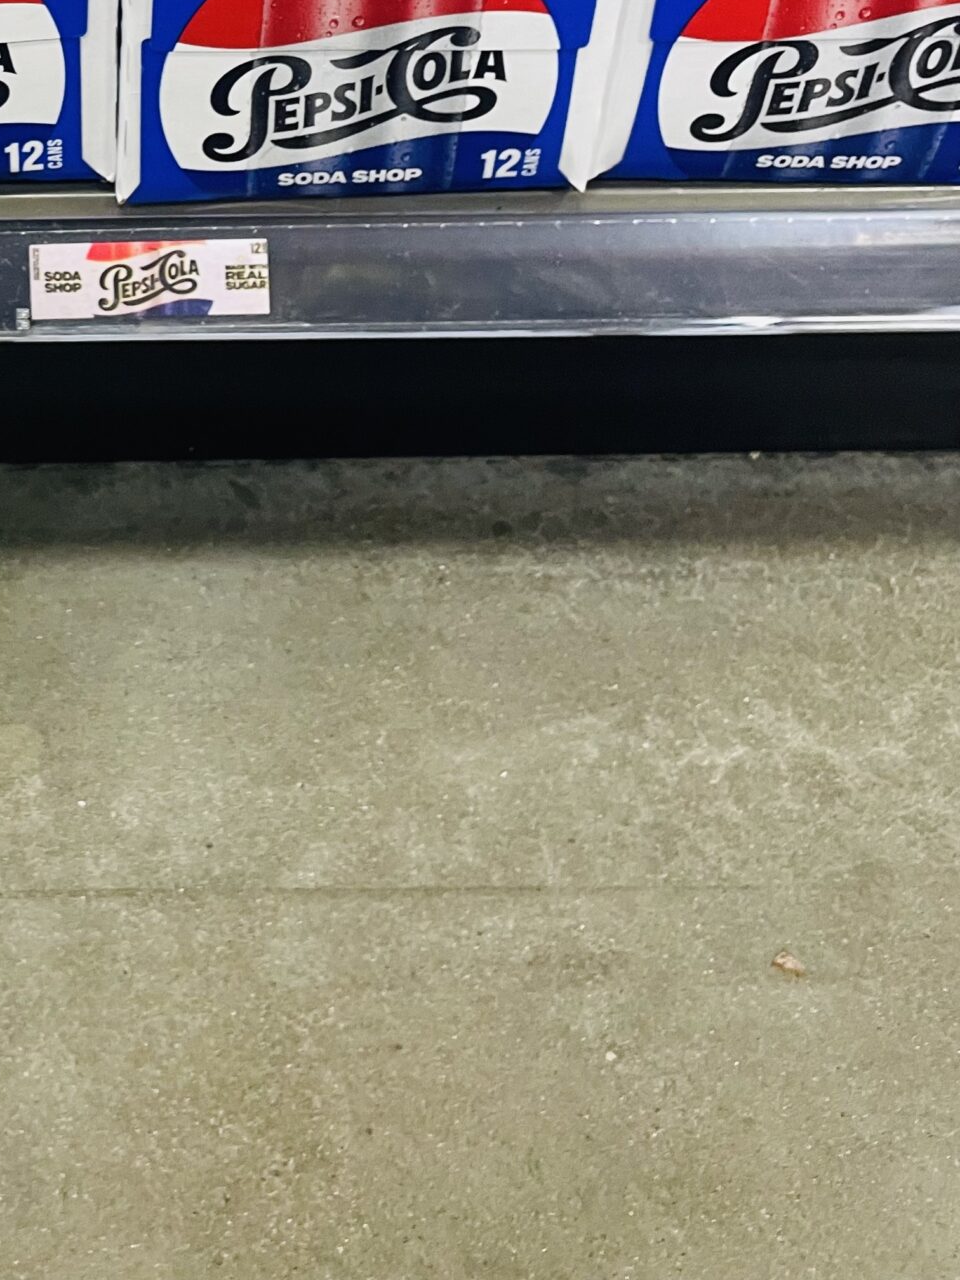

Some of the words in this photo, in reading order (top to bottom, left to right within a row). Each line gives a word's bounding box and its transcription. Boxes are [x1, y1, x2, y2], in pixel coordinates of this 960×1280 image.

[4, 140, 45, 172] 12
[47, 138, 63, 169] CANS
[481, 149, 521, 178] 12
[521, 149, 541, 177] CANS
[756, 155, 825, 169] SODA
[830, 155, 902, 169] SHOP
[277, 171, 347, 186] SODA
[351, 167, 422, 183] SHOP
[45, 272, 81, 281] SODA
[225, 271, 267, 281] REAL
[45, 283, 82, 293] SHOP
[226, 281, 267, 290] SUGAR
